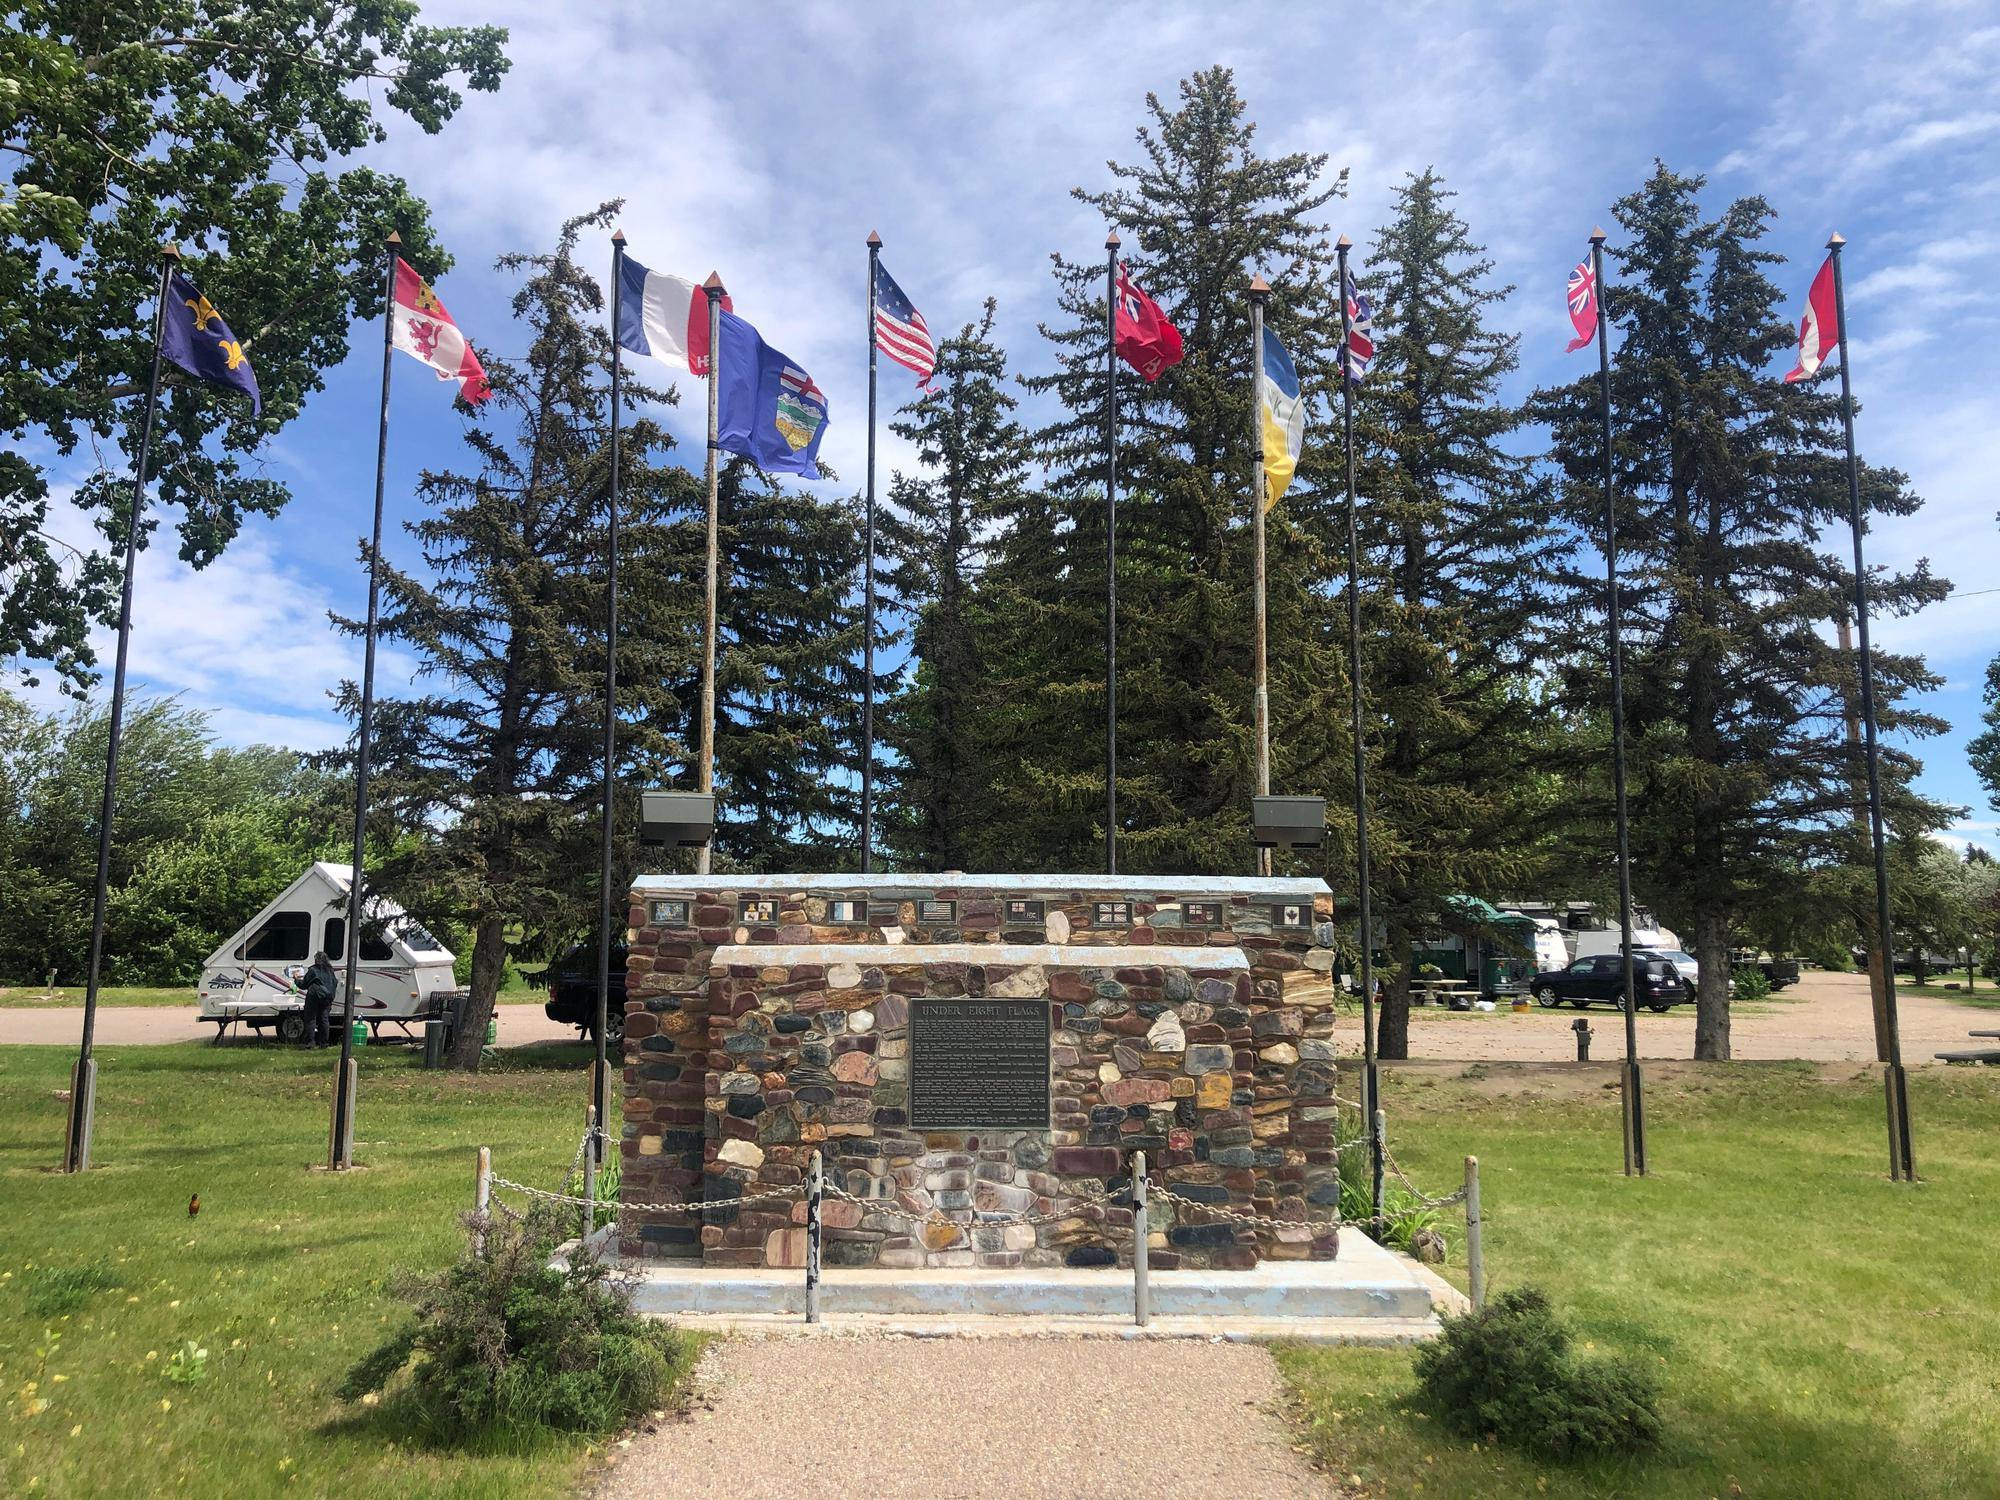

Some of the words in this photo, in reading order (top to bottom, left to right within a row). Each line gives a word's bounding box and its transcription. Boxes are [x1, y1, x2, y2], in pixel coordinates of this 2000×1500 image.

[922, 1006, 962, 1016] UNDER
[968, 1006, 1001, 1016] EIGHT
[1008, 1006, 1040, 1016] FLAGS
